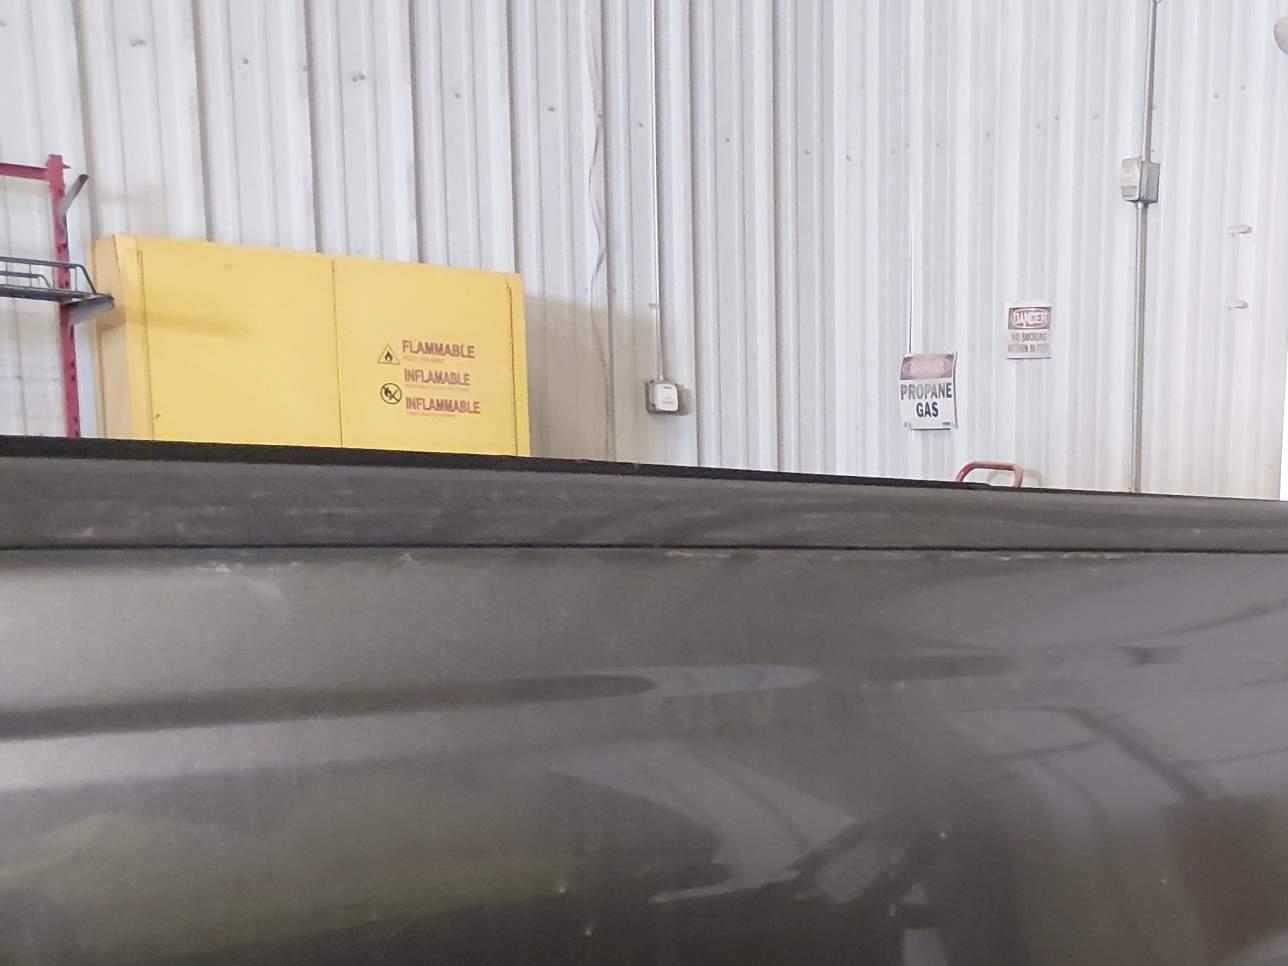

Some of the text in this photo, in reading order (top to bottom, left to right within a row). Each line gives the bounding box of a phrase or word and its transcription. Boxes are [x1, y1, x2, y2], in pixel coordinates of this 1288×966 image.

[402, 340, 475, 359] FLAMMABLE
[404, 368, 471, 386] INFLAMABLE
[900, 382, 952, 401] PROPANE
[405, 396, 481, 415] INFLAMMABLE
[916, 402, 939, 418] GAS
